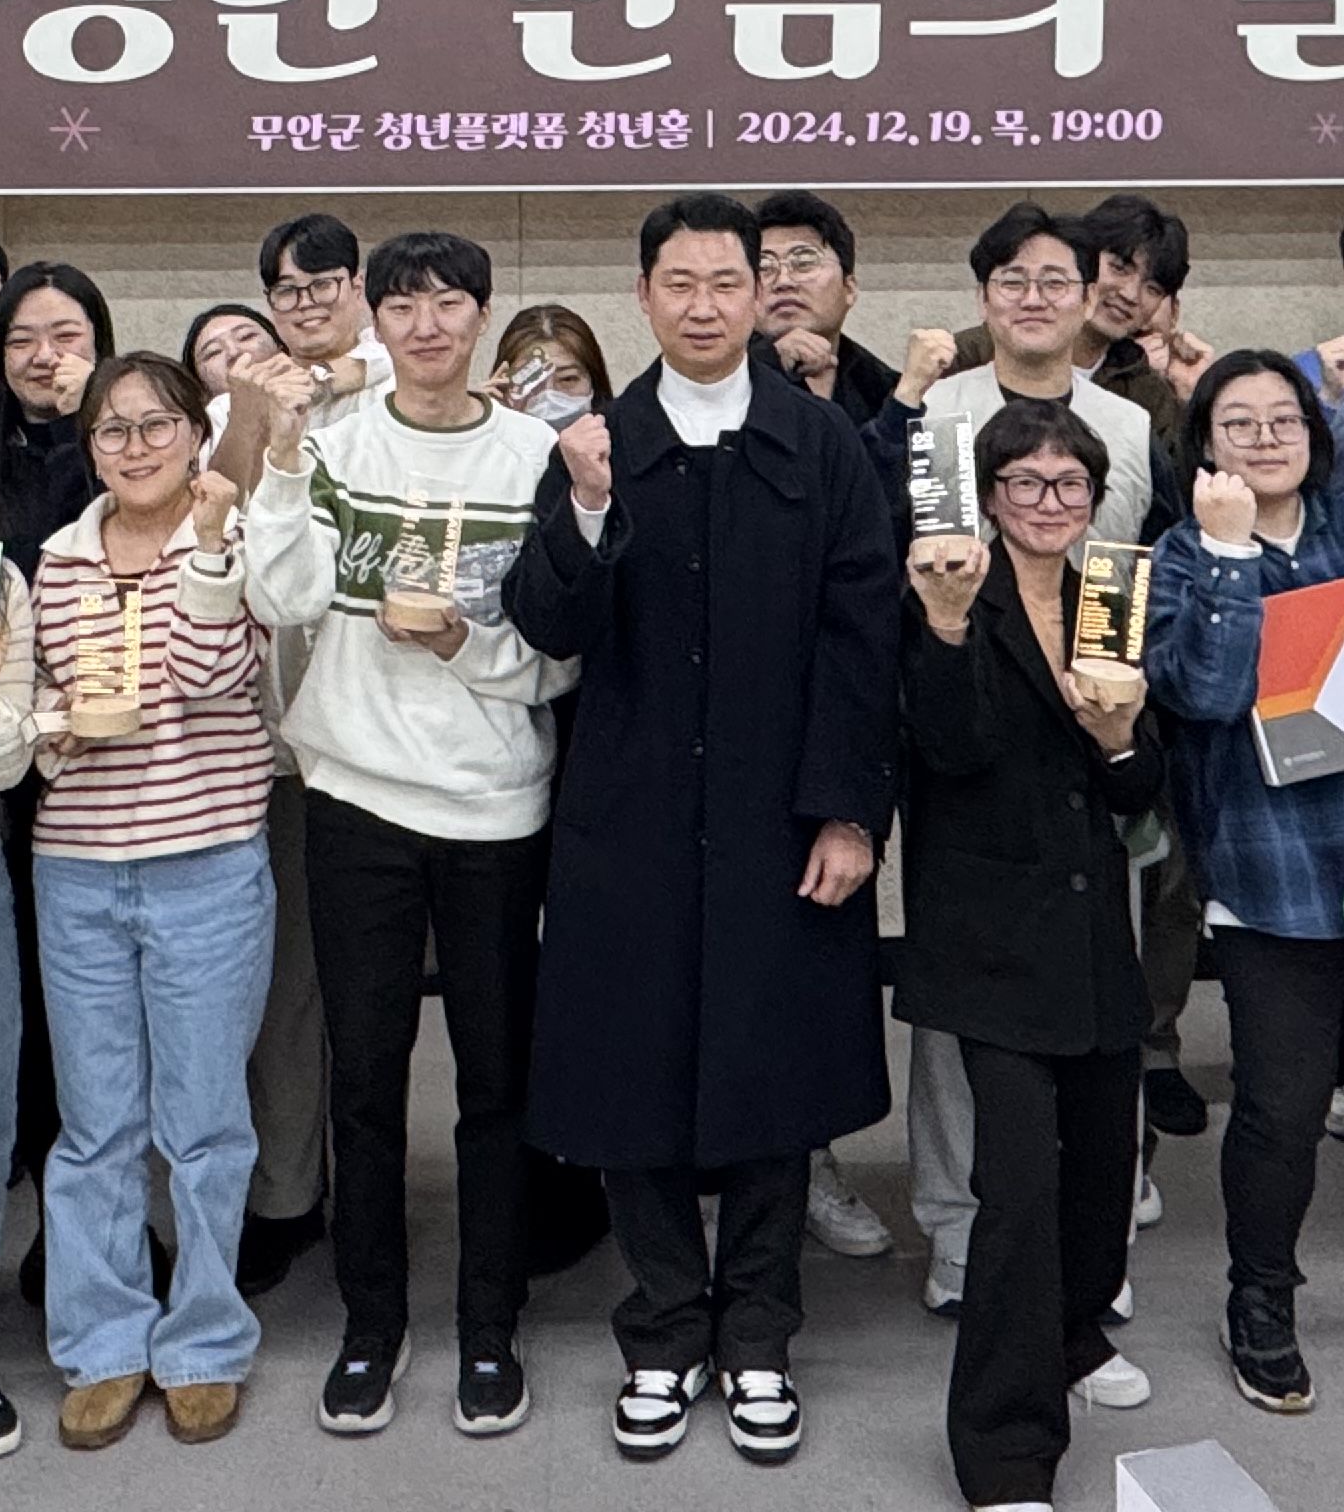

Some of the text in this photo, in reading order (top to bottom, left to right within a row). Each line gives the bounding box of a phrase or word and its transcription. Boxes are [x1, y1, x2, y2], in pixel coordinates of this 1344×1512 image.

[247, 108, 1163, 151] 무안군 청년플랫폼 청년홀 2024. 12. 19. 목. 19:00
